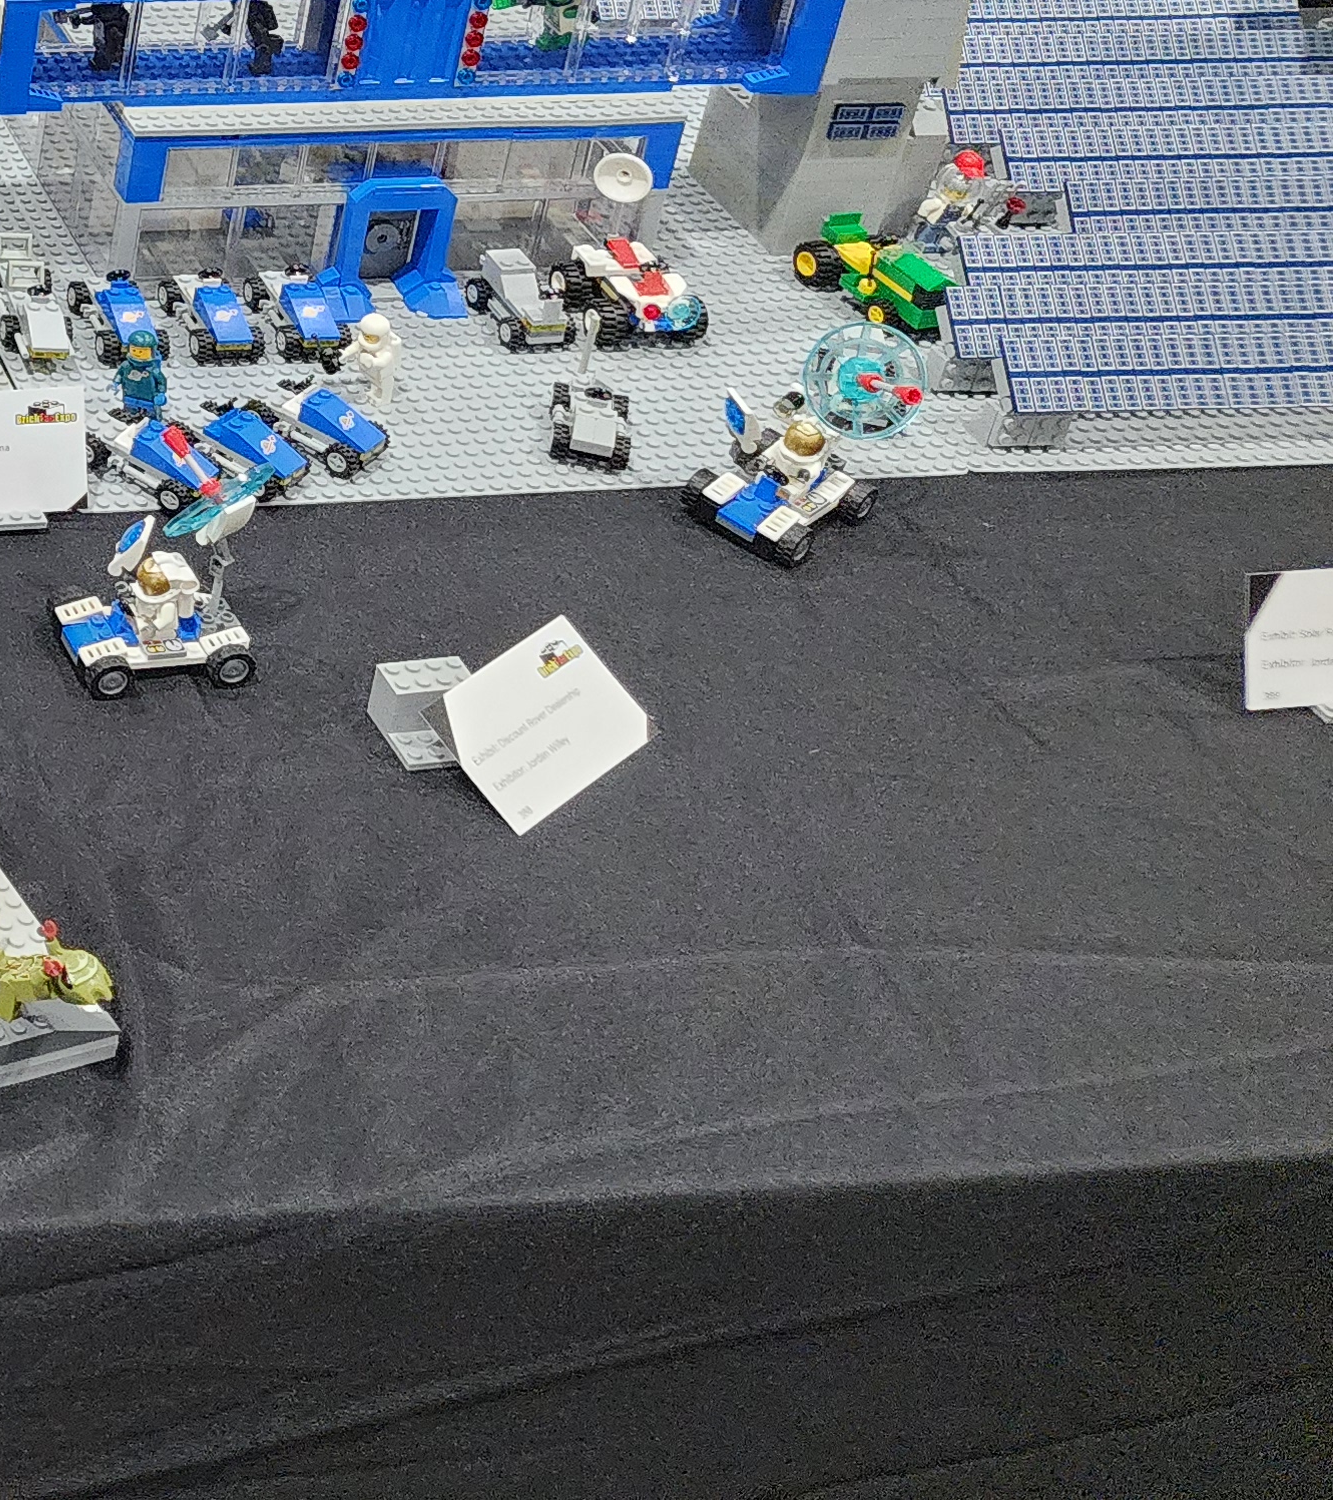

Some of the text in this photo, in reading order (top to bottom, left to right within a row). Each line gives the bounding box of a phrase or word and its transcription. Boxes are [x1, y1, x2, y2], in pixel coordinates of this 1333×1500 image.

[496, 721, 530, 750] Discount
[526, 709, 549, 730] Rover
[528, 748, 553, 772] Jordan
[547, 735, 572, 757] Willey
